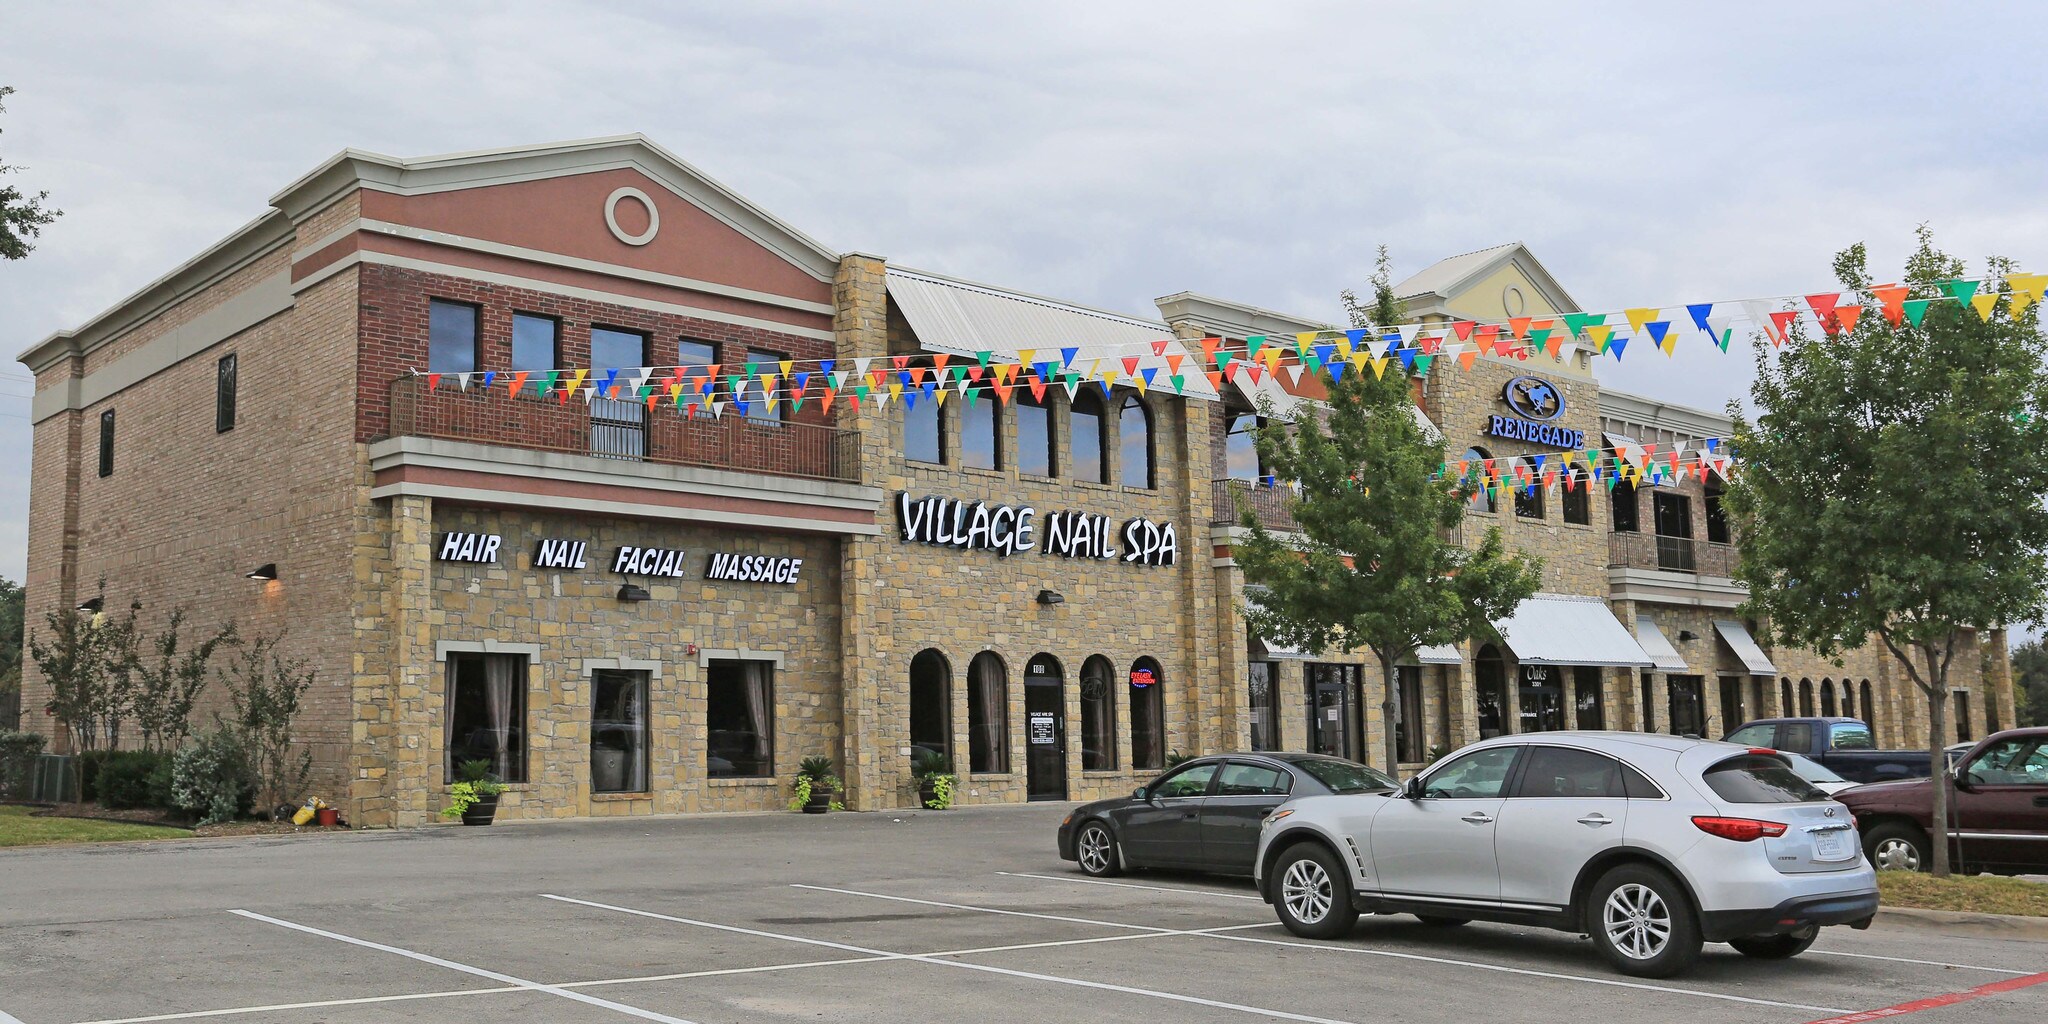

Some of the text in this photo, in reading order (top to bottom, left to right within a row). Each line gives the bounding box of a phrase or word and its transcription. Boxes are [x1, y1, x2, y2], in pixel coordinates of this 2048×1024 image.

[1491, 415, 1585, 450] RENEGADE
[901, 491, 1177, 566] VILLAGE NAIL SPA
[440, 532, 803, 584] HAIR NAIL FACIAL MASSAGE
[1130, 671, 1152, 679] EYELASH
[1526, 665, 1547, 681] Oaks
